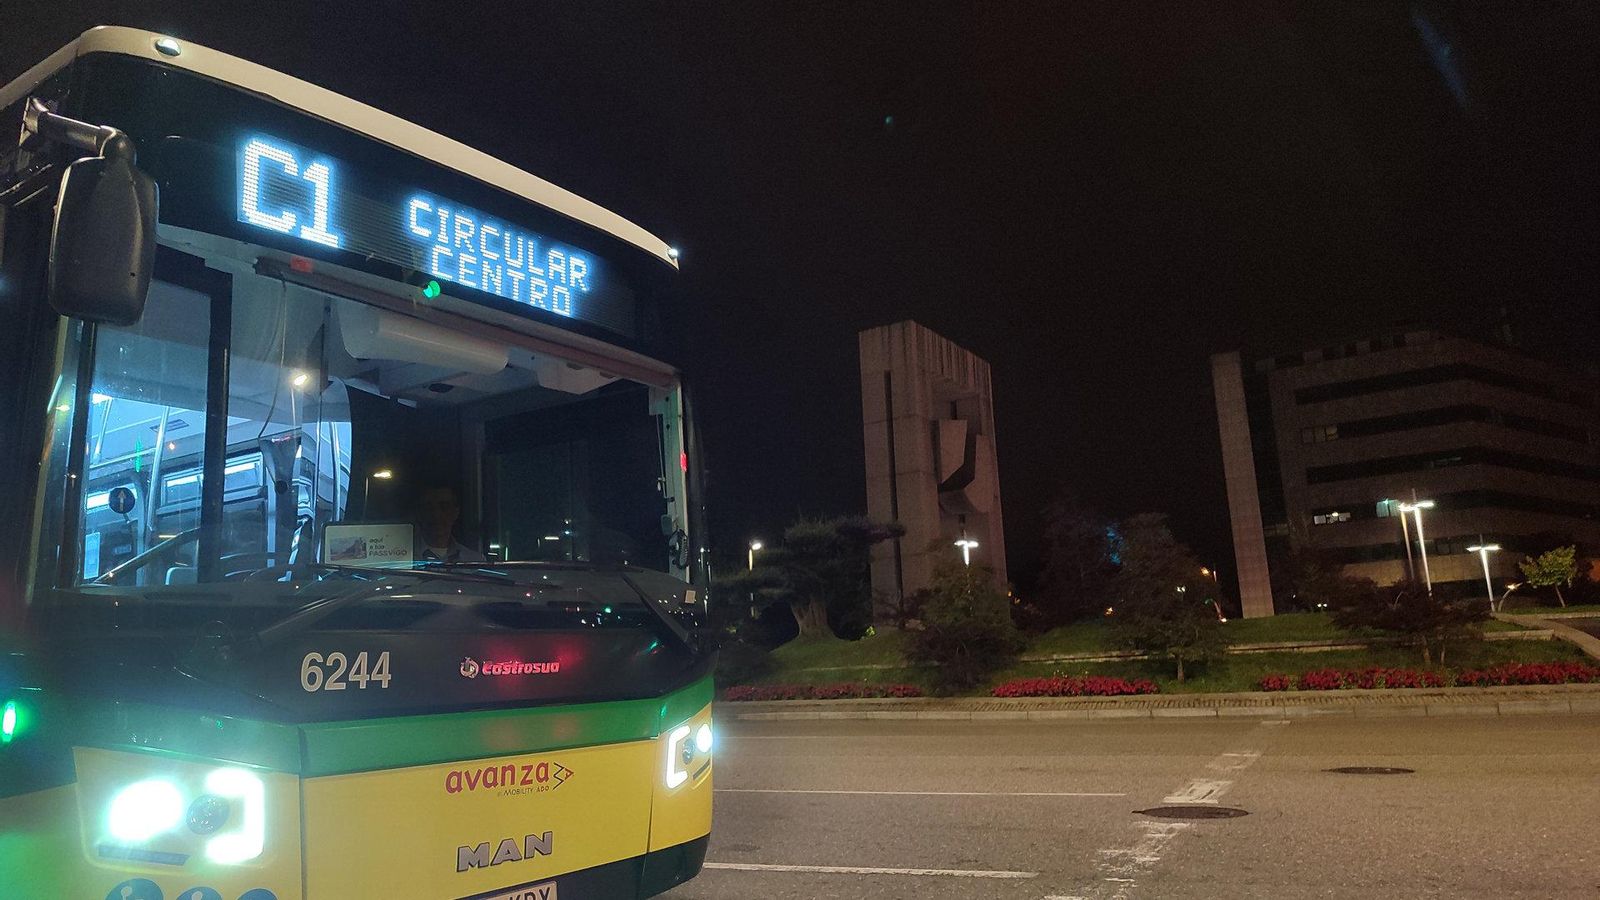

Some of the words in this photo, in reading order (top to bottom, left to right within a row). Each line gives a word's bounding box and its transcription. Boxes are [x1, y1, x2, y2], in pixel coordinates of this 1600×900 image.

[243, 139, 339, 249] C1
[408, 198, 589, 292] CIRCULAR
[430, 246, 573, 317] CENTRO
[301, 651, 391, 692] 6244
[445, 762, 549, 794] avanza
[504, 788, 533, 796] MOBILITY
[456, 831, 553, 872] MAN
